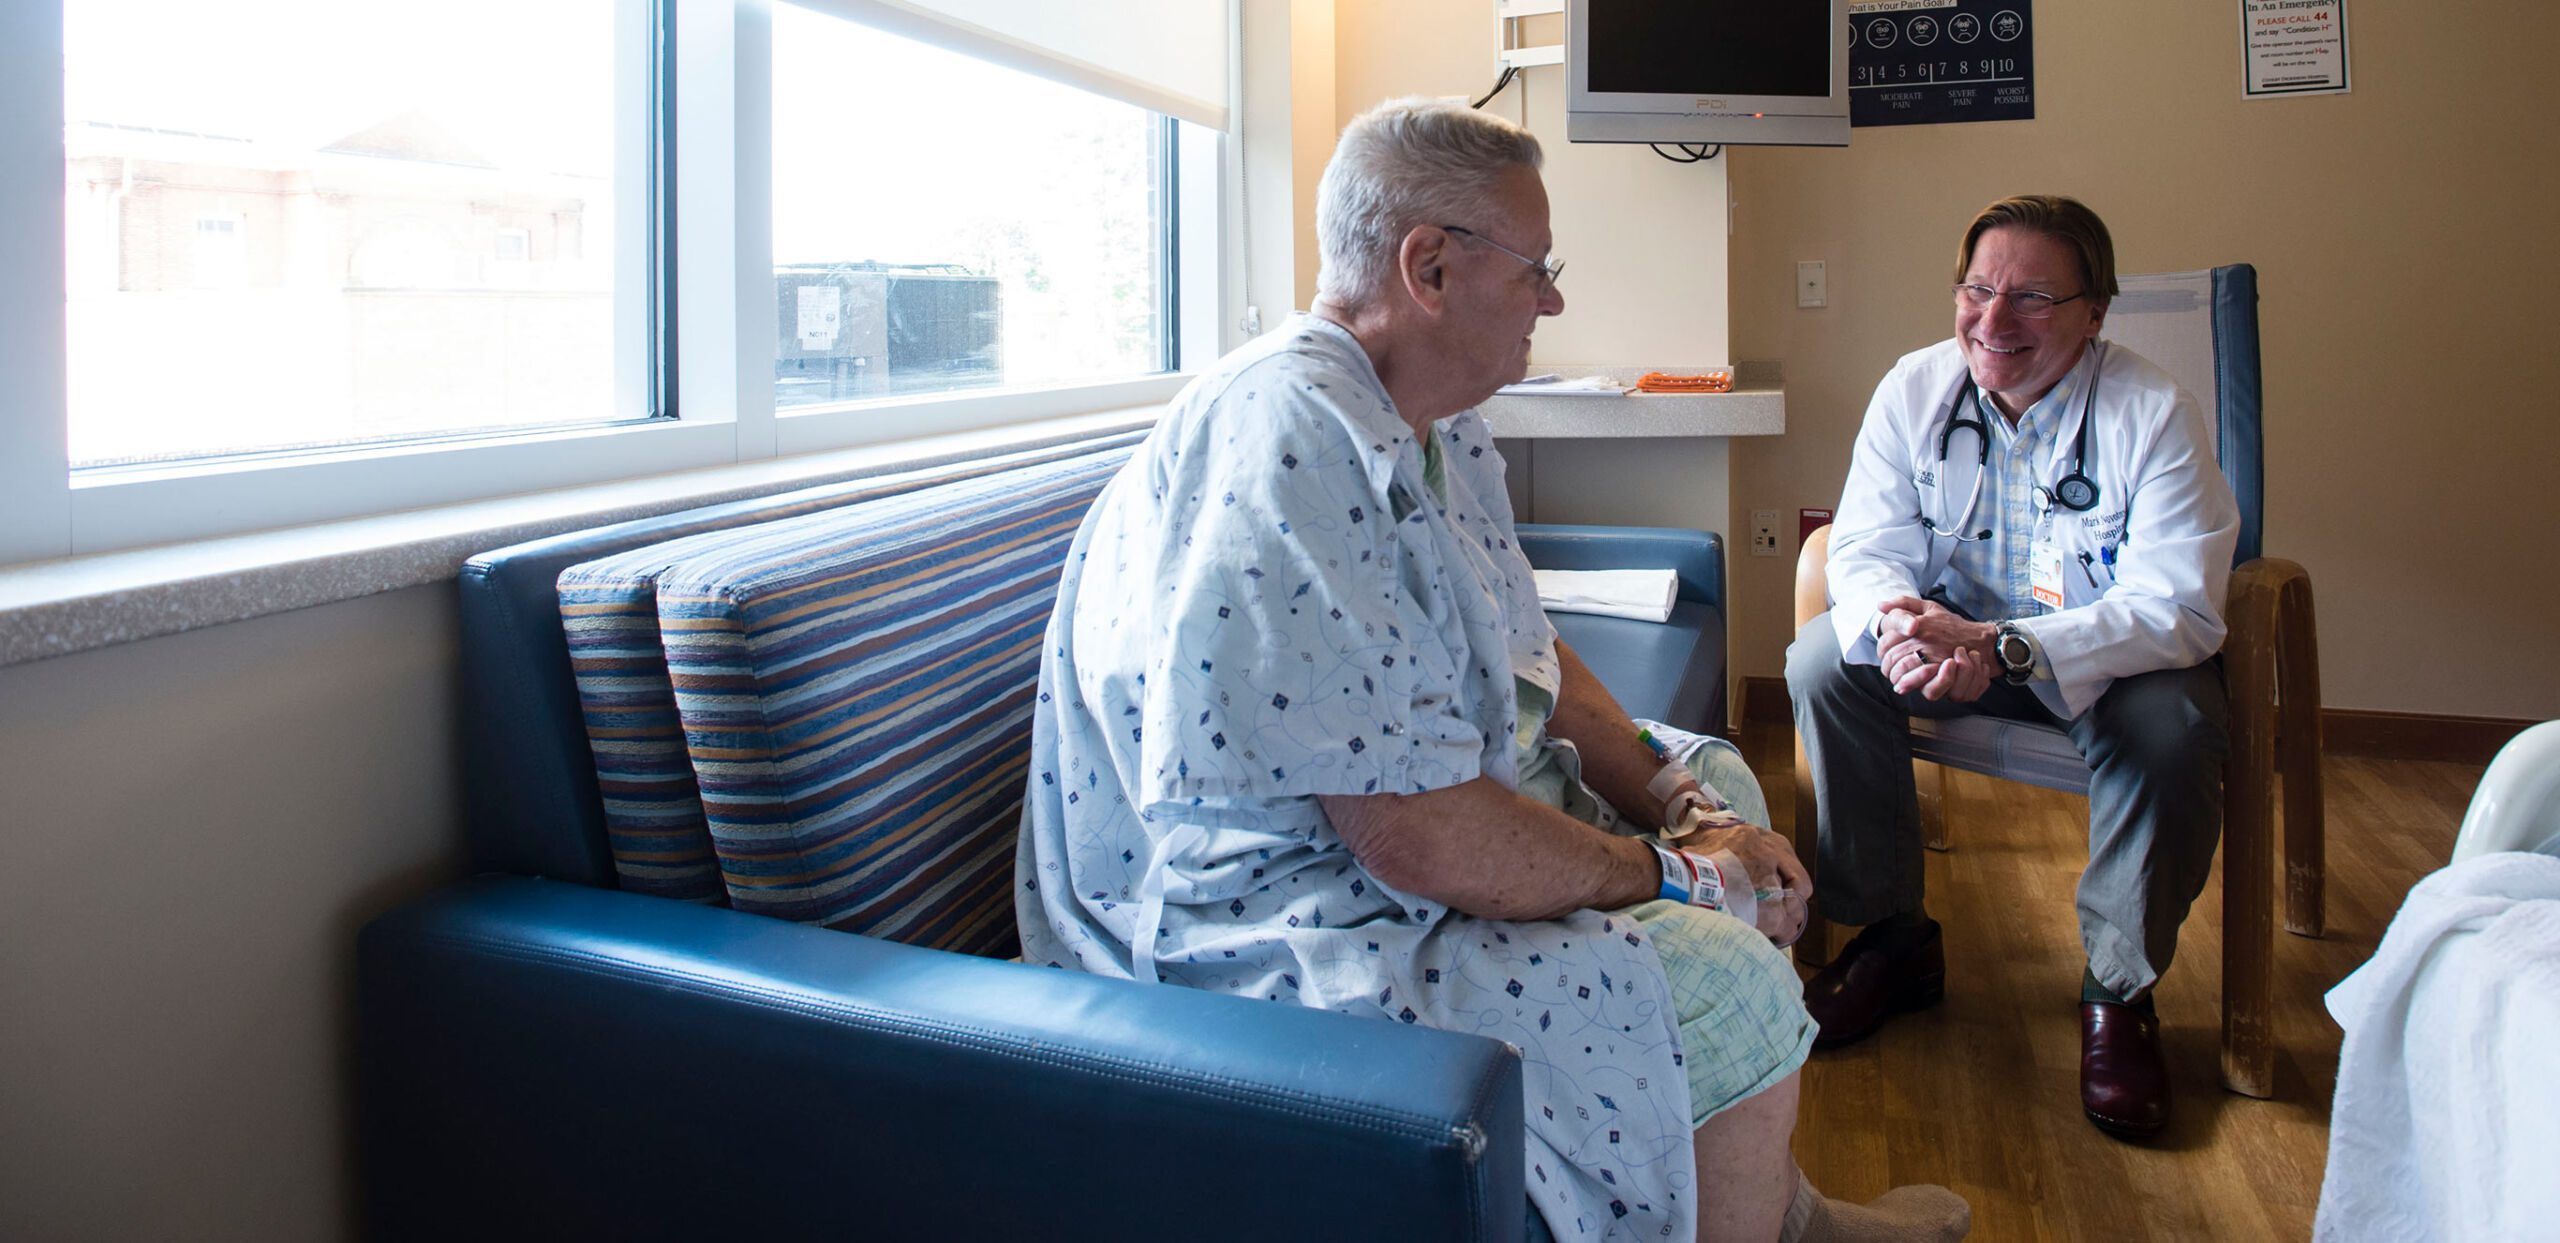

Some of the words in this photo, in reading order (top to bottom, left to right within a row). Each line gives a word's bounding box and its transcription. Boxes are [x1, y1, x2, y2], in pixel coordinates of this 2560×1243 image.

[1876, 2, 1898, 10] Your
[1900, 0, 1921, 9] Pain
[2248, 4, 2258, 12] In
[2261, 3, 2276, 11] An
[2279, 0, 2337, 9] Emergency
[2257, 16, 2286, 25] PLEASE
[2289, 15, 2311, 23] CALL
[2314, 12, 2328, 21] 44
[2268, 29, 2279, 37] say
[1858, 66, 1866, 80] 3
[1877, 65, 1886, 79] 4
[1898, 64, 1906, 78] 5
[1918, 63, 1927, 77] 6
[1939, 62, 1947, 75] 7
[1960, 60, 1968, 74] 8
[1980, 59, 1989, 73] 9
[1999, 58, 2014, 72] 10
[1948, 88, 1977, 98] SEVERE
[1997, 86, 2026, 96] WORST
[1880, 91, 1923, 102] MODERATE
[1953, 97, 1972, 106] PAIN
[1994, 94, 2030, 105] POSSIBLE
[1892, 101, 1911, 109] PAIN
[2081, 515, 2100, 528] Mark
